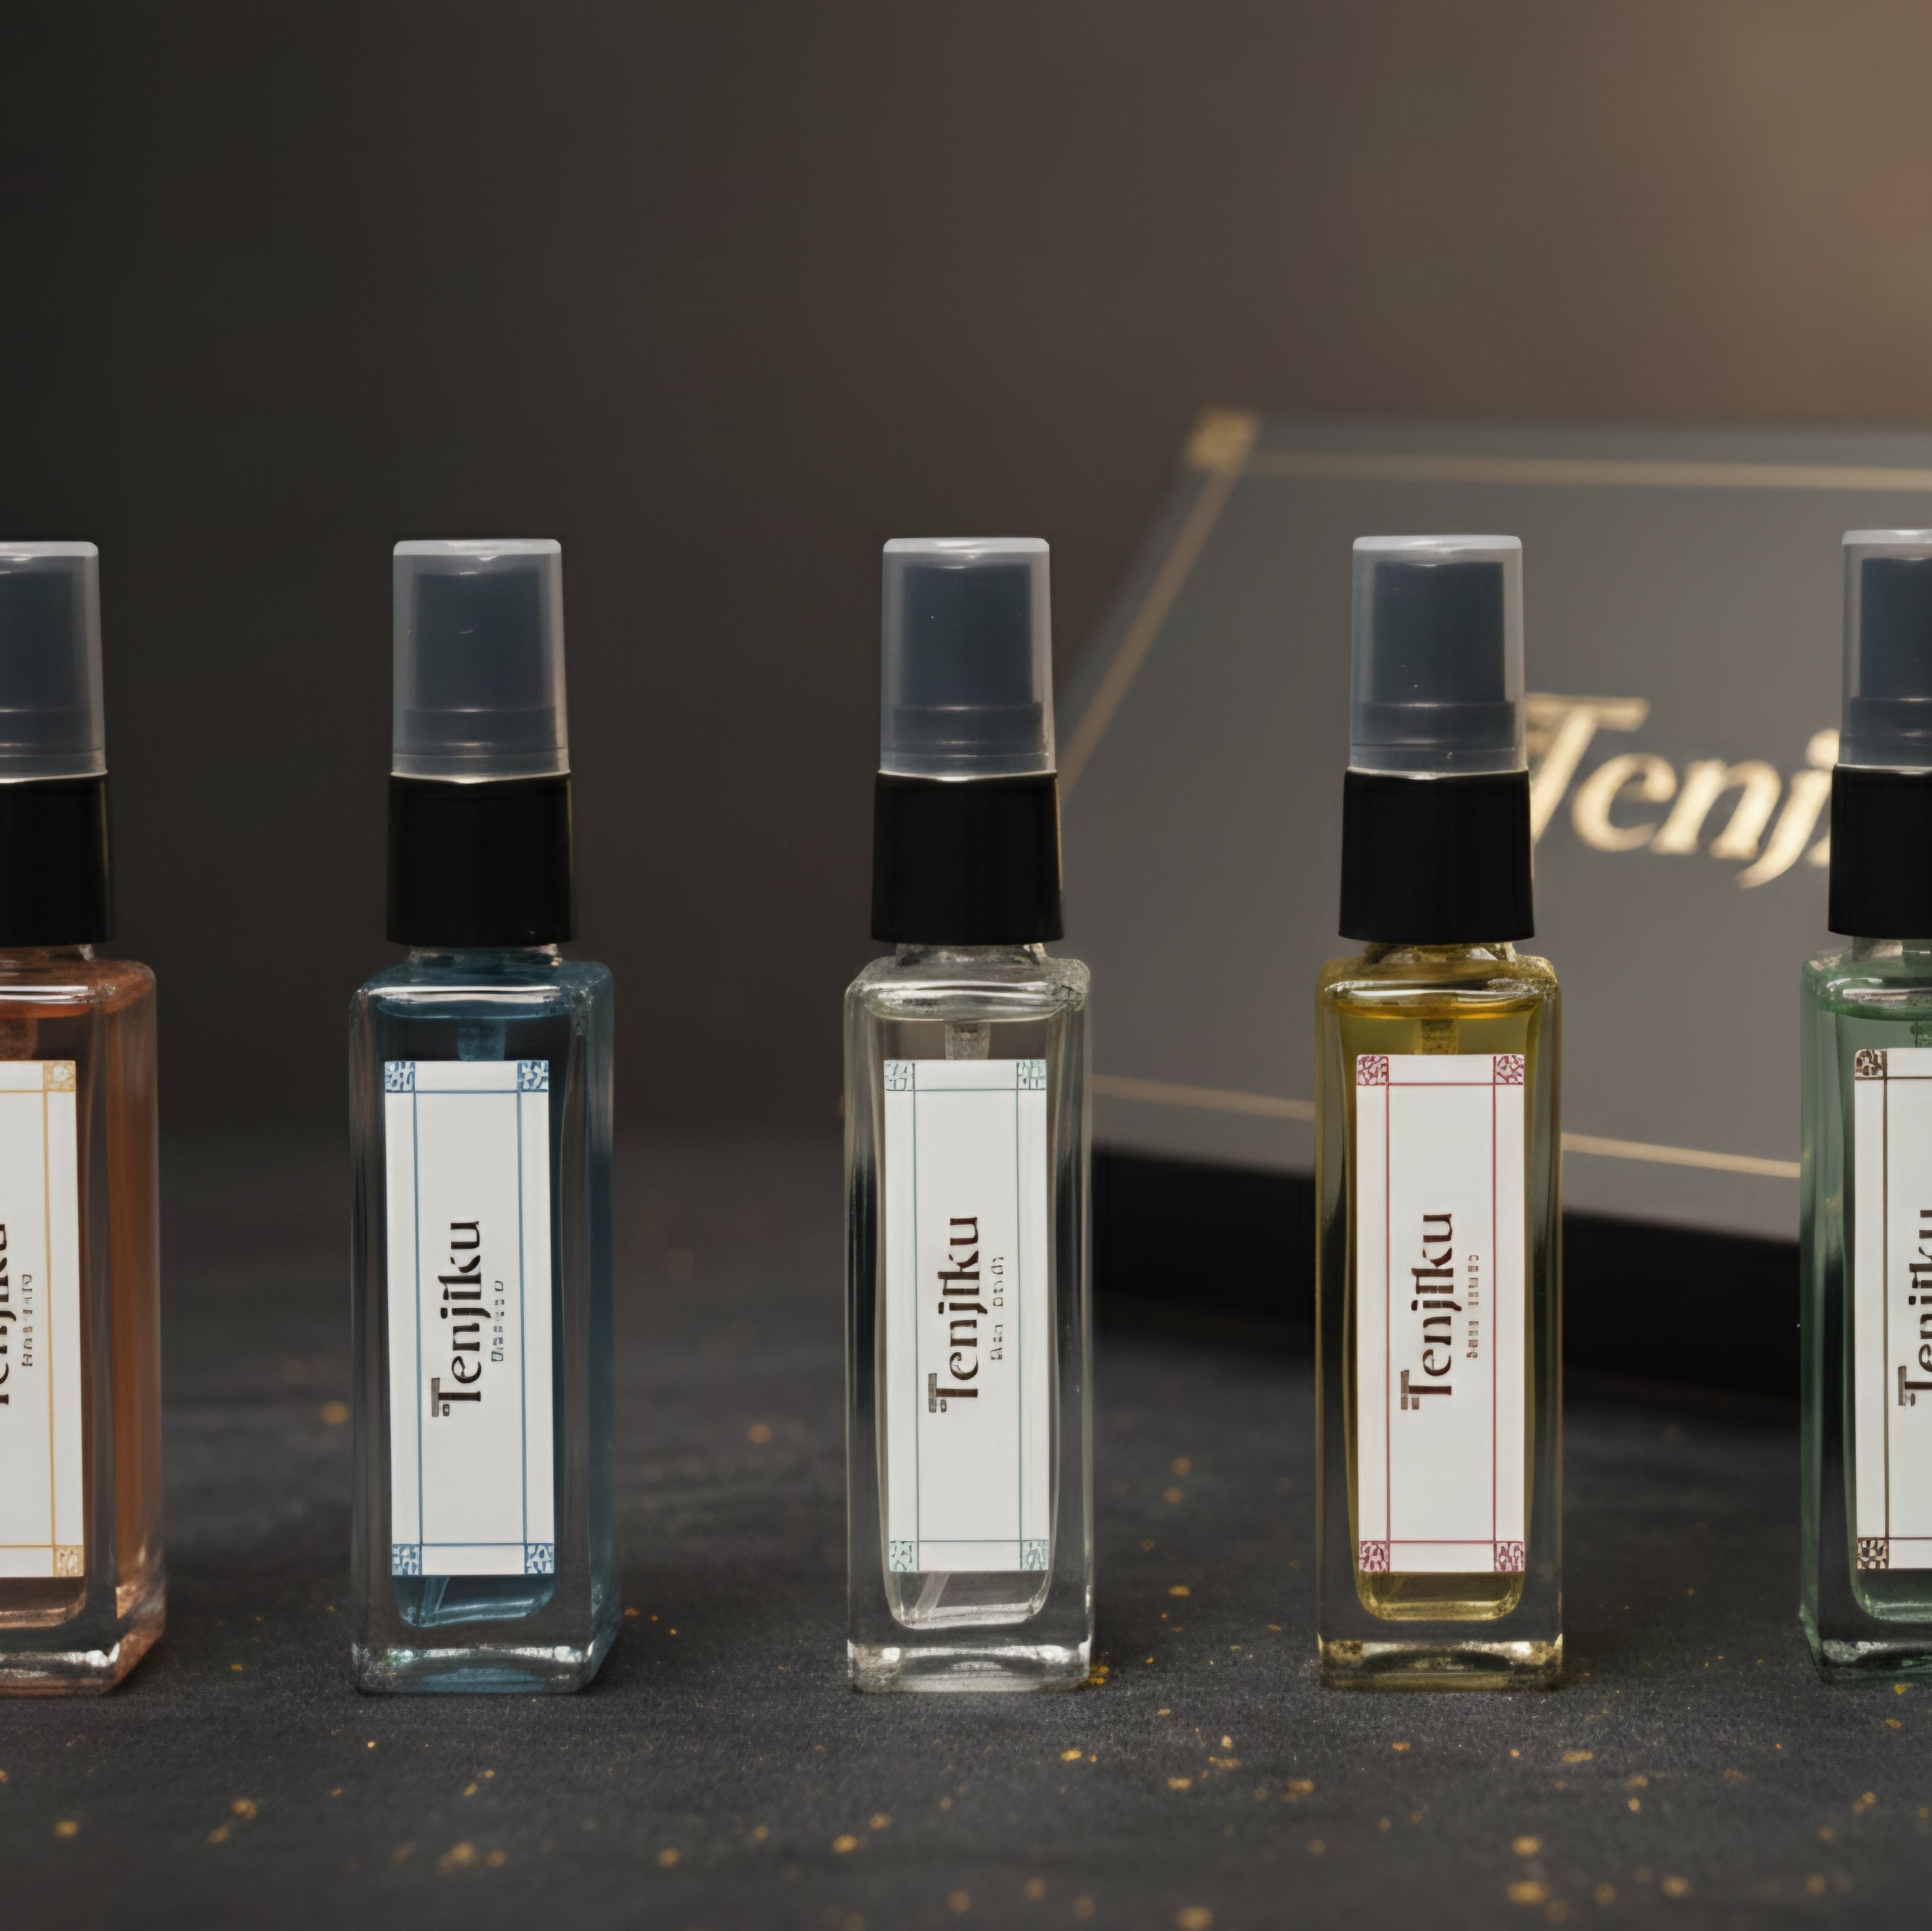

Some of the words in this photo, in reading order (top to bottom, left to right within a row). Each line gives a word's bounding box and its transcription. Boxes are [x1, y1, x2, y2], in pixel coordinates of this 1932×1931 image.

[430, 1220, 491, 1417] Tenjiku
[928, 1216, 989, 1414] Tenjiku
[1400, 1213, 1462, 1410] Tenjiku
